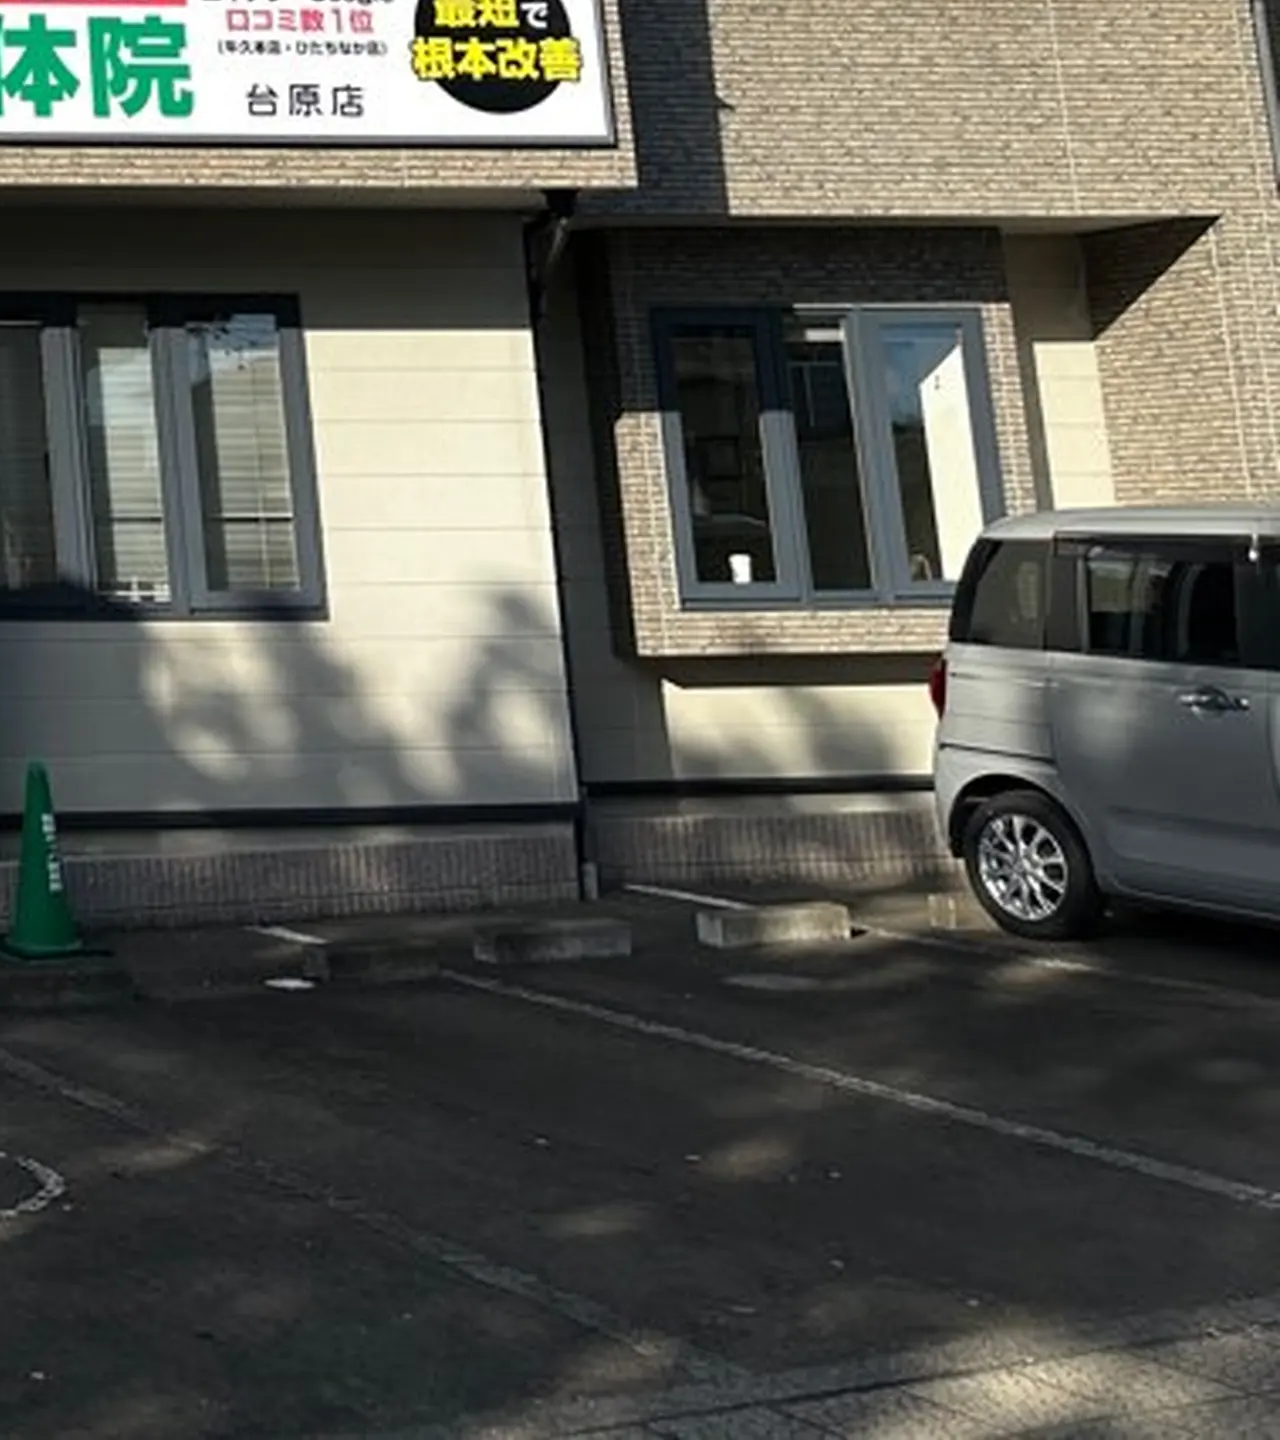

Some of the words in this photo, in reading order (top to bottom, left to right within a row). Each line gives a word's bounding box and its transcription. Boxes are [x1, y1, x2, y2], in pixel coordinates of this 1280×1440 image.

[410, 37, 583, 82] 根本改善
[246, 83, 366, 118] 台原店
